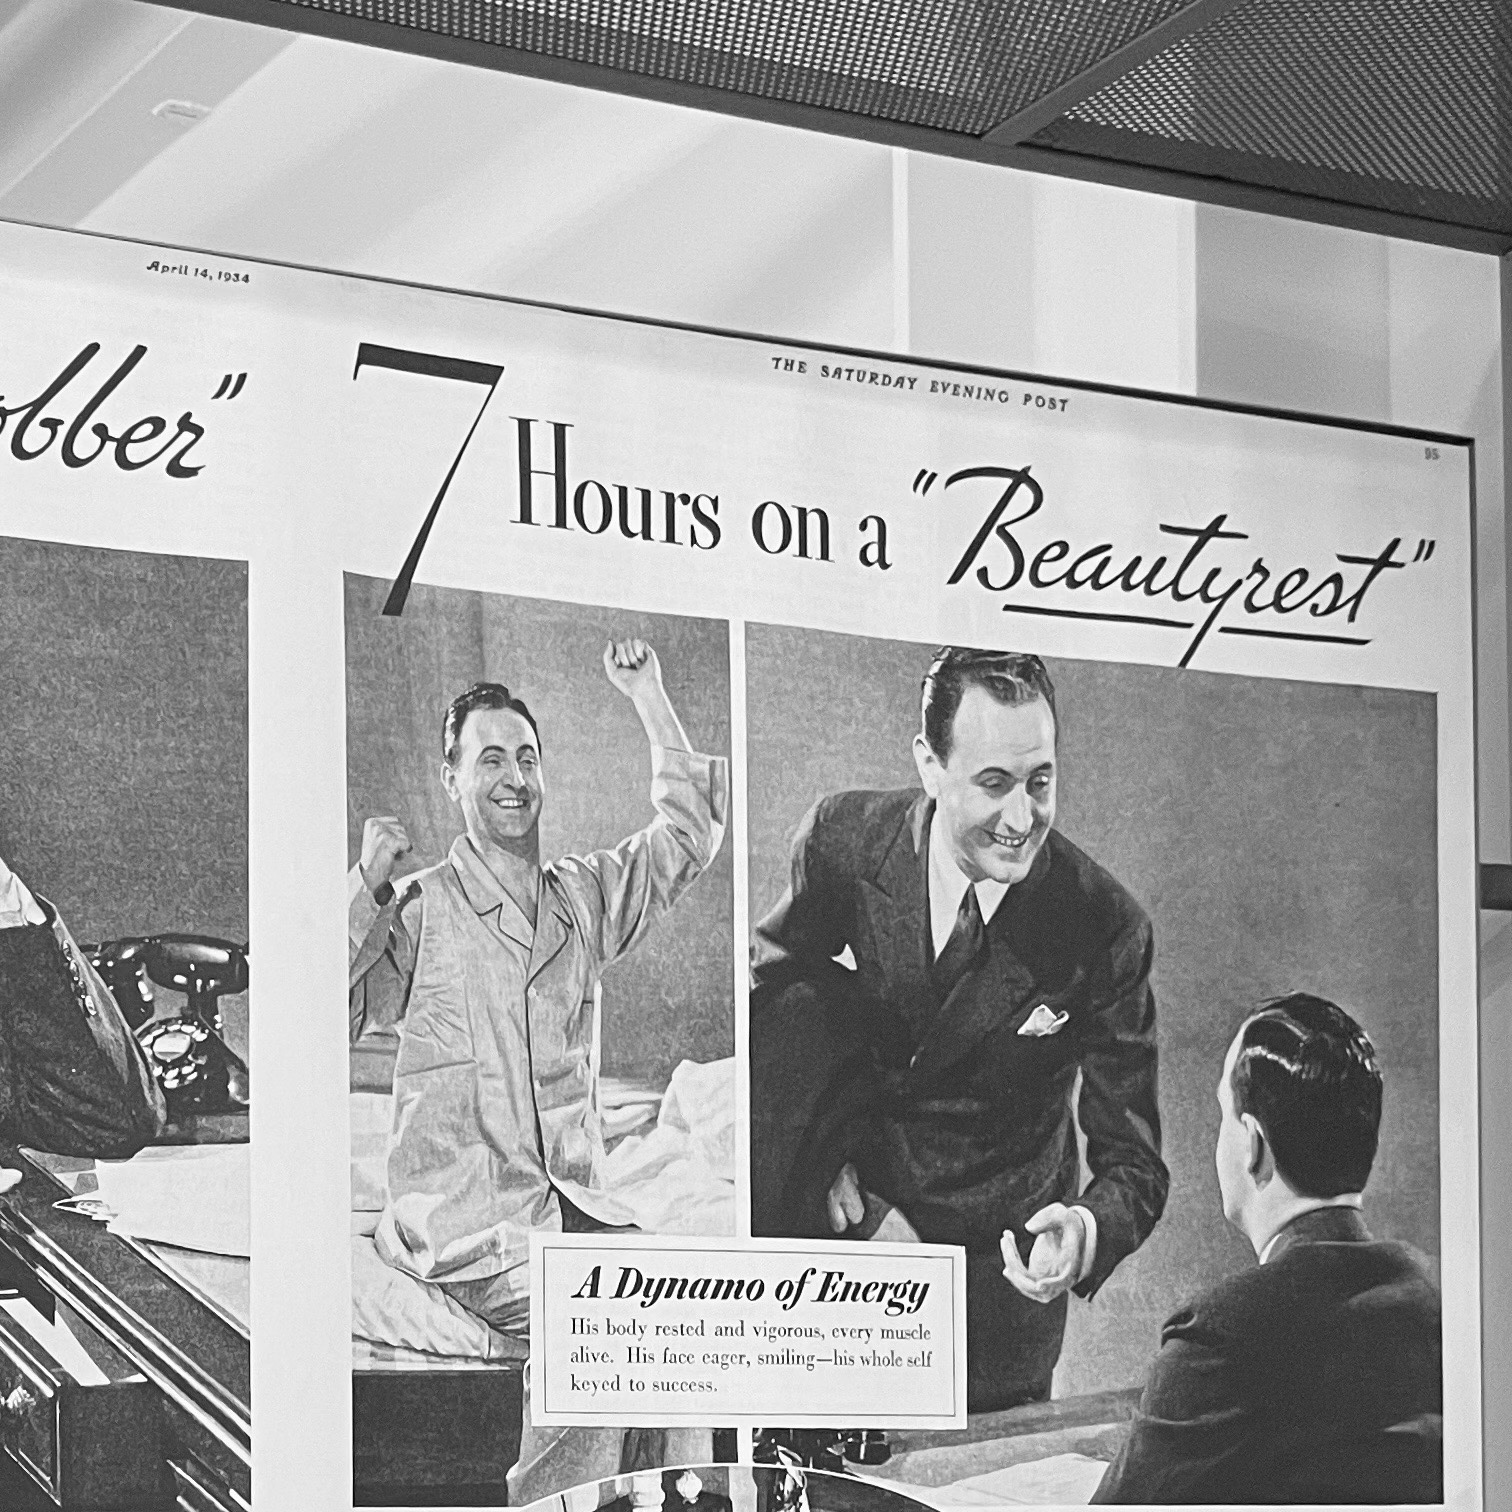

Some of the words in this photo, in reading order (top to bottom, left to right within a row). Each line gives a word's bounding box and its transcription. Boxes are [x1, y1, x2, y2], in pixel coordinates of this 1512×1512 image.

[147, 261, 188, 275] April
[195, 268, 212, 280] 14,
[218, 271, 249, 283] 1934
[772, 357, 807, 373] THE
[821, 365, 917, 390] SATURDAY
[930, 380, 1009, 403] EVENING
[1023, 394, 1068, 412] POST
[351, 342, 506, 617] 7
[510, 417, 721, 549] Hours
[752, 501, 832, 562] on
[859, 515, 892, 570] a
[910, 464, 1437, 669] "Beautyrest"
[571, 1266, 602, 1298] A
[609, 1267, 764, 1308] Dynamo
[775, 1268, 816, 1311] of
[812, 1271, 930, 1316] Energy
[572, 1318, 598, 1336] His
[607, 1318, 646, 1341] body
[656, 1320, 704, 1336] rested
[715, 1320, 744, 1337] and
[753, 1324, 824, 1341] vigorous,
[832, 1327, 871, 1344] every
[881, 1324, 930, 1339] muscle
[571, 1346, 613, 1363] alive.
[628, 1347, 654, 1363] His
[663, 1347, 694, 1363] face
[703, 1351, 750, 1370] eager,
[860, 1350, 902, 1366] whole
[908, 1351, 932, 1367] self
[571, 1374, 620, 1395] keyed
[630, 1378, 645, 1391] to
[653, 1380, 717, 1392] success.
